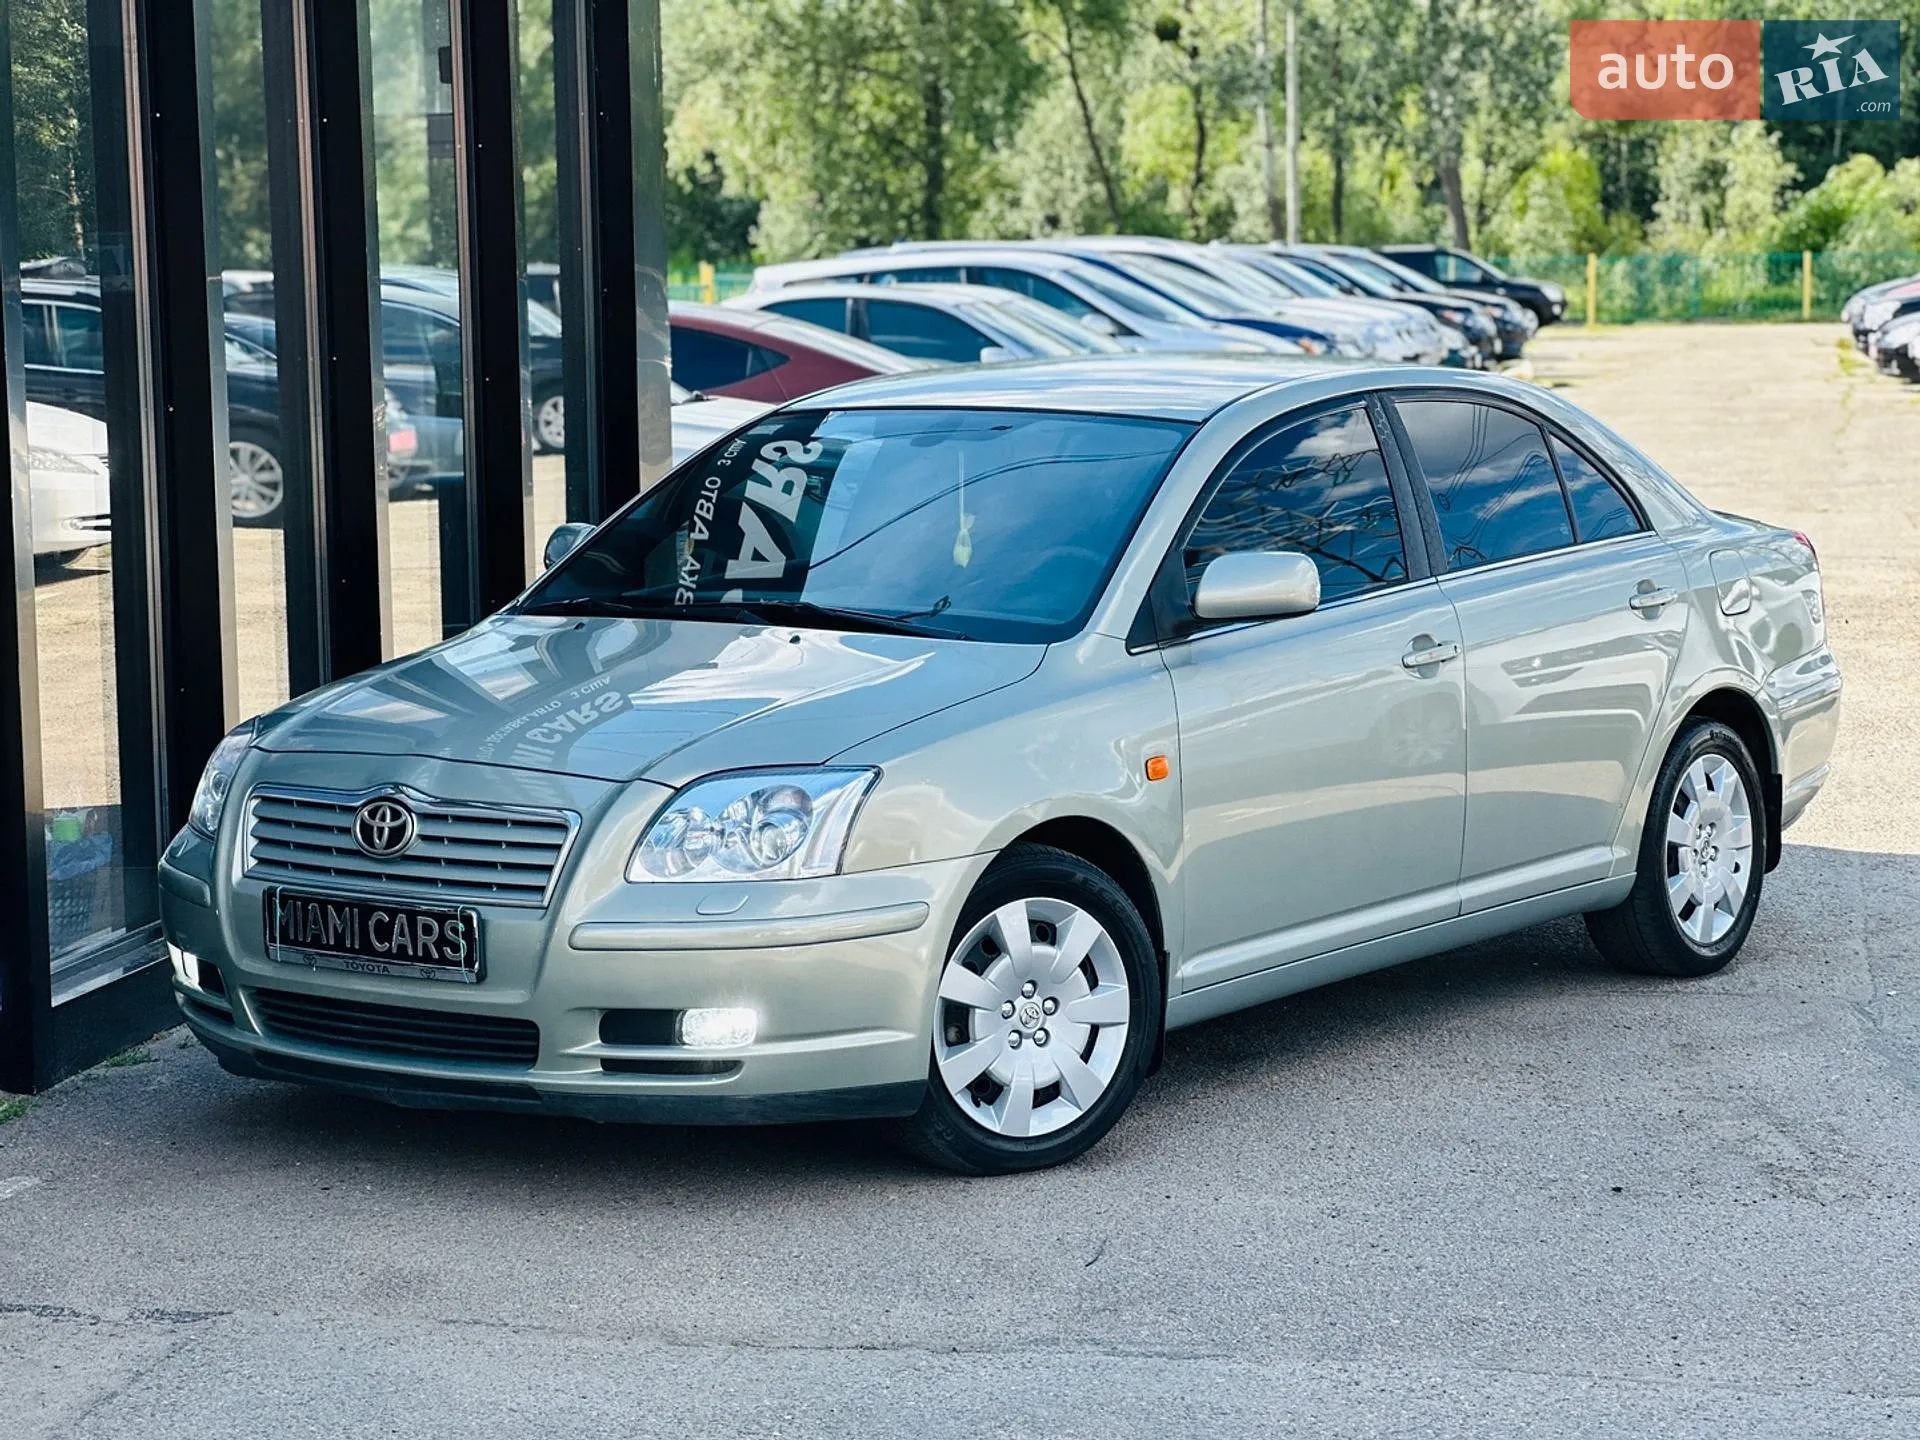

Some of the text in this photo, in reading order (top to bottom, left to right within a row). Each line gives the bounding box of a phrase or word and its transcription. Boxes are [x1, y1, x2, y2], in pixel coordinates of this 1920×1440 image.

[272, 897, 468, 961] MIAMI CARS
[344, 961, 391, 974] TOYOTA
